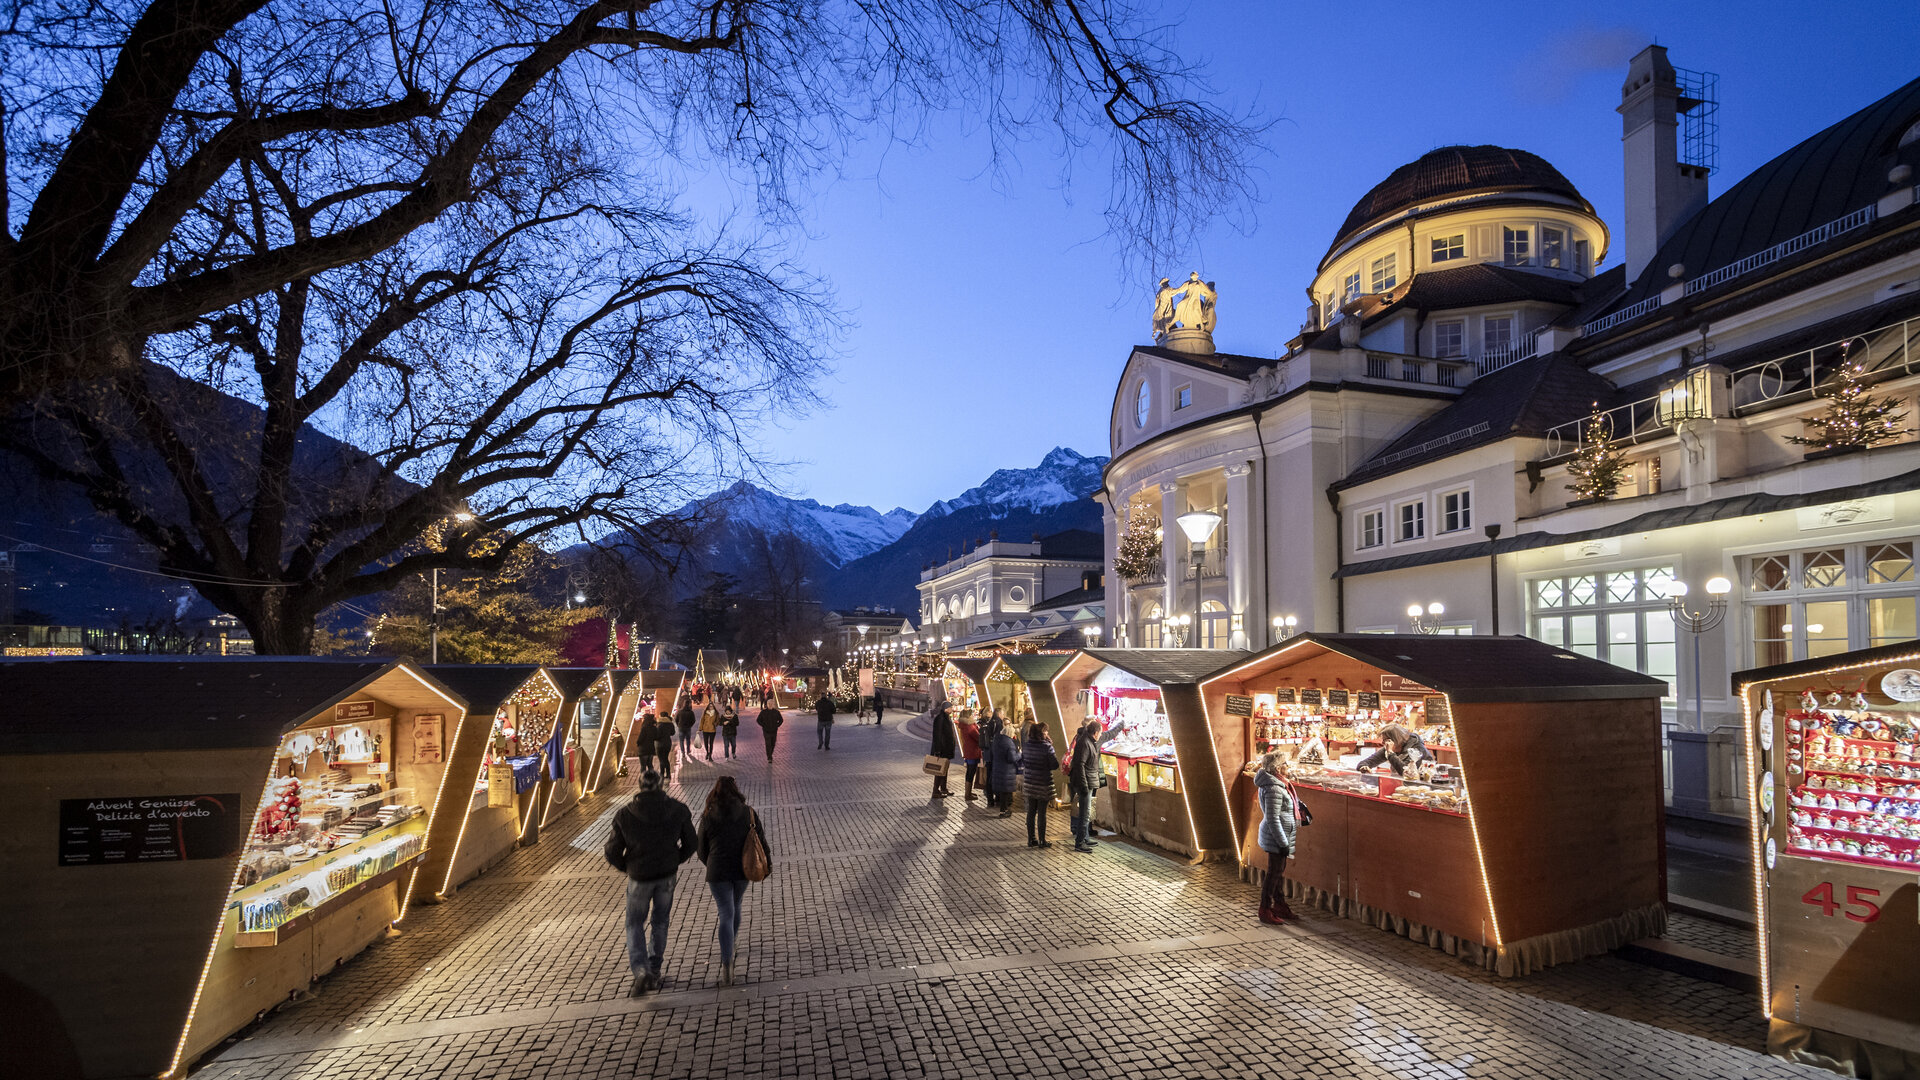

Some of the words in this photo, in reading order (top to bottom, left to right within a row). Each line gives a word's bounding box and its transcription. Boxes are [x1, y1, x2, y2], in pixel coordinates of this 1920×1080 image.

[337, 708, 344, 716] 43
[87, 800, 134, 811] Advent
[139, 798, 197, 809] Genüsse
[96, 811, 142, 822] Delizie
[147, 808, 211, 820] d'avvento
[1801, 881, 1881, 923] 45
